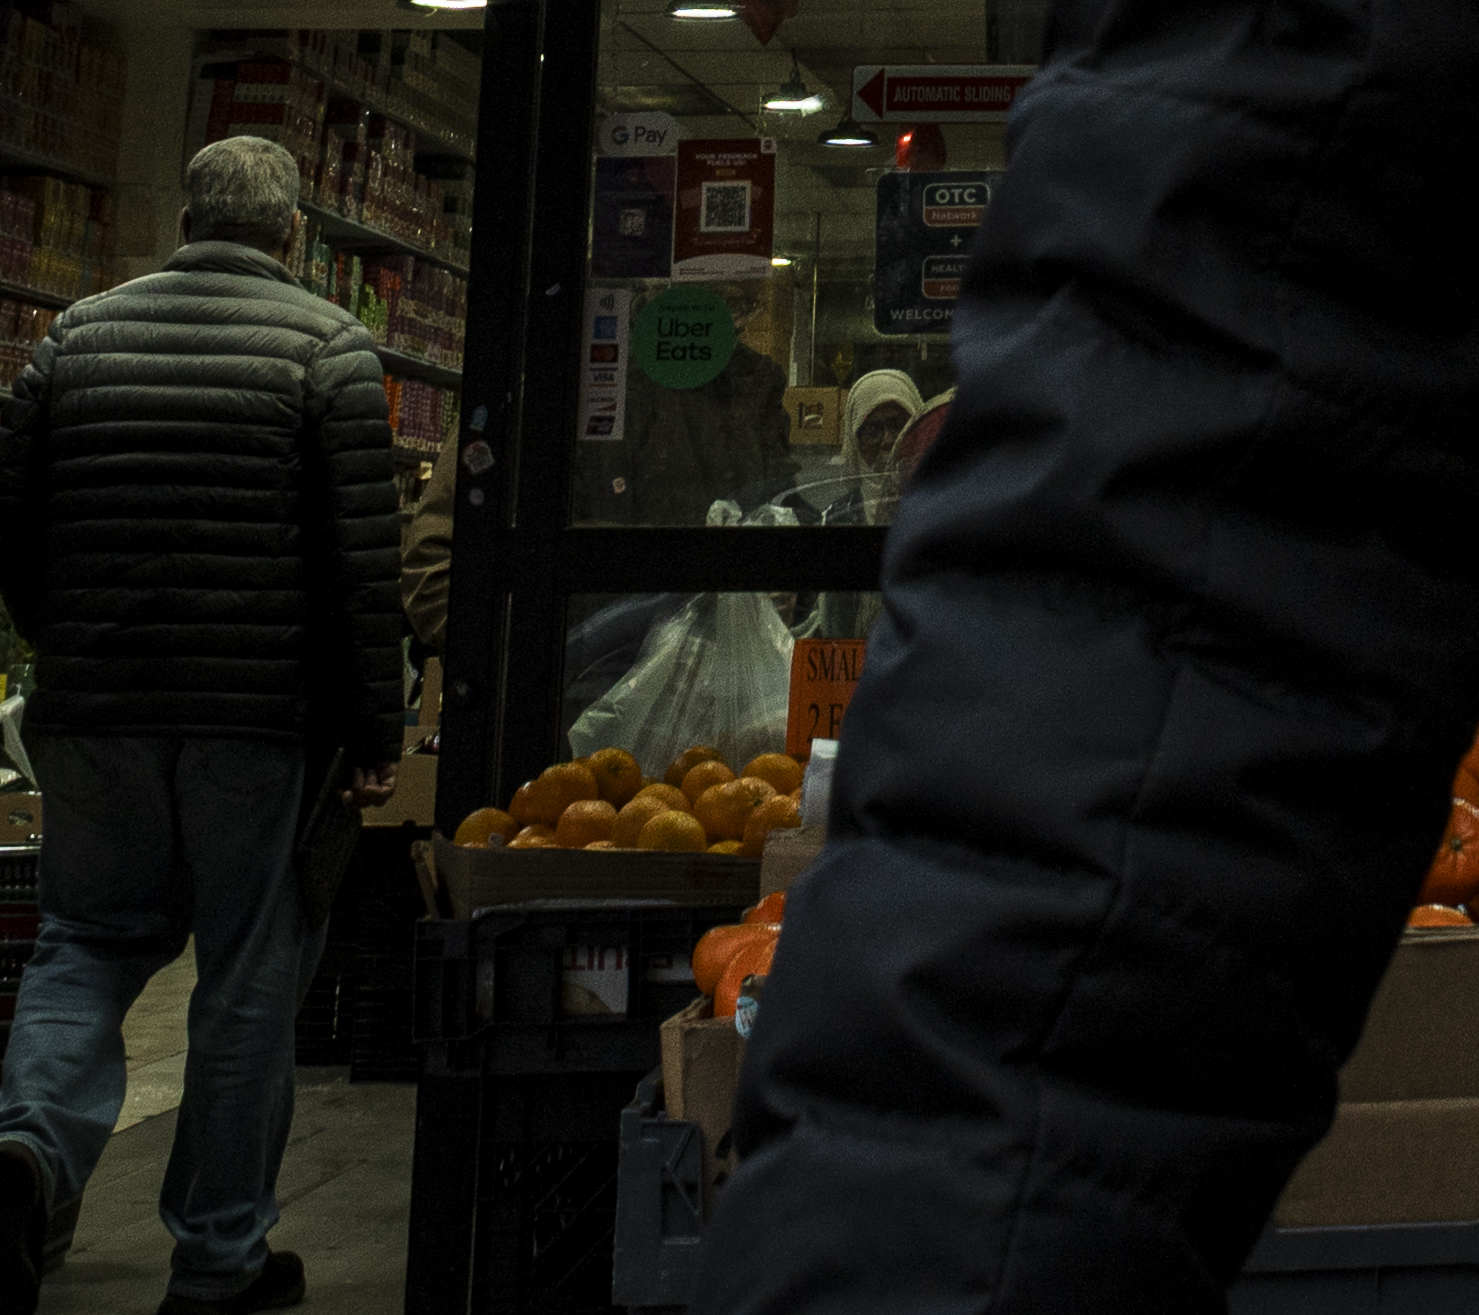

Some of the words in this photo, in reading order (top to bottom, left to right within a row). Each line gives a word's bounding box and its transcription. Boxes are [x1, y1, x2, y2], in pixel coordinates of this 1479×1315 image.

[893, 85, 960, 103] AUTOMATIC
[964, 86, 1012, 103] SLIDING
[634, 125, 668, 147] Pay
[934, 188, 978, 204] OTC
[931, 210, 978, 221] Network
[931, 264, 967, 273] HEALT
[889, 309, 954, 321] WELCOM
[657, 317, 714, 338] Uber
[655, 340, 712, 362] Eats
[593, 373, 615, 382] VISA
[806, 646, 859, 682] SMAL
[806, 703, 820, 743] 2
